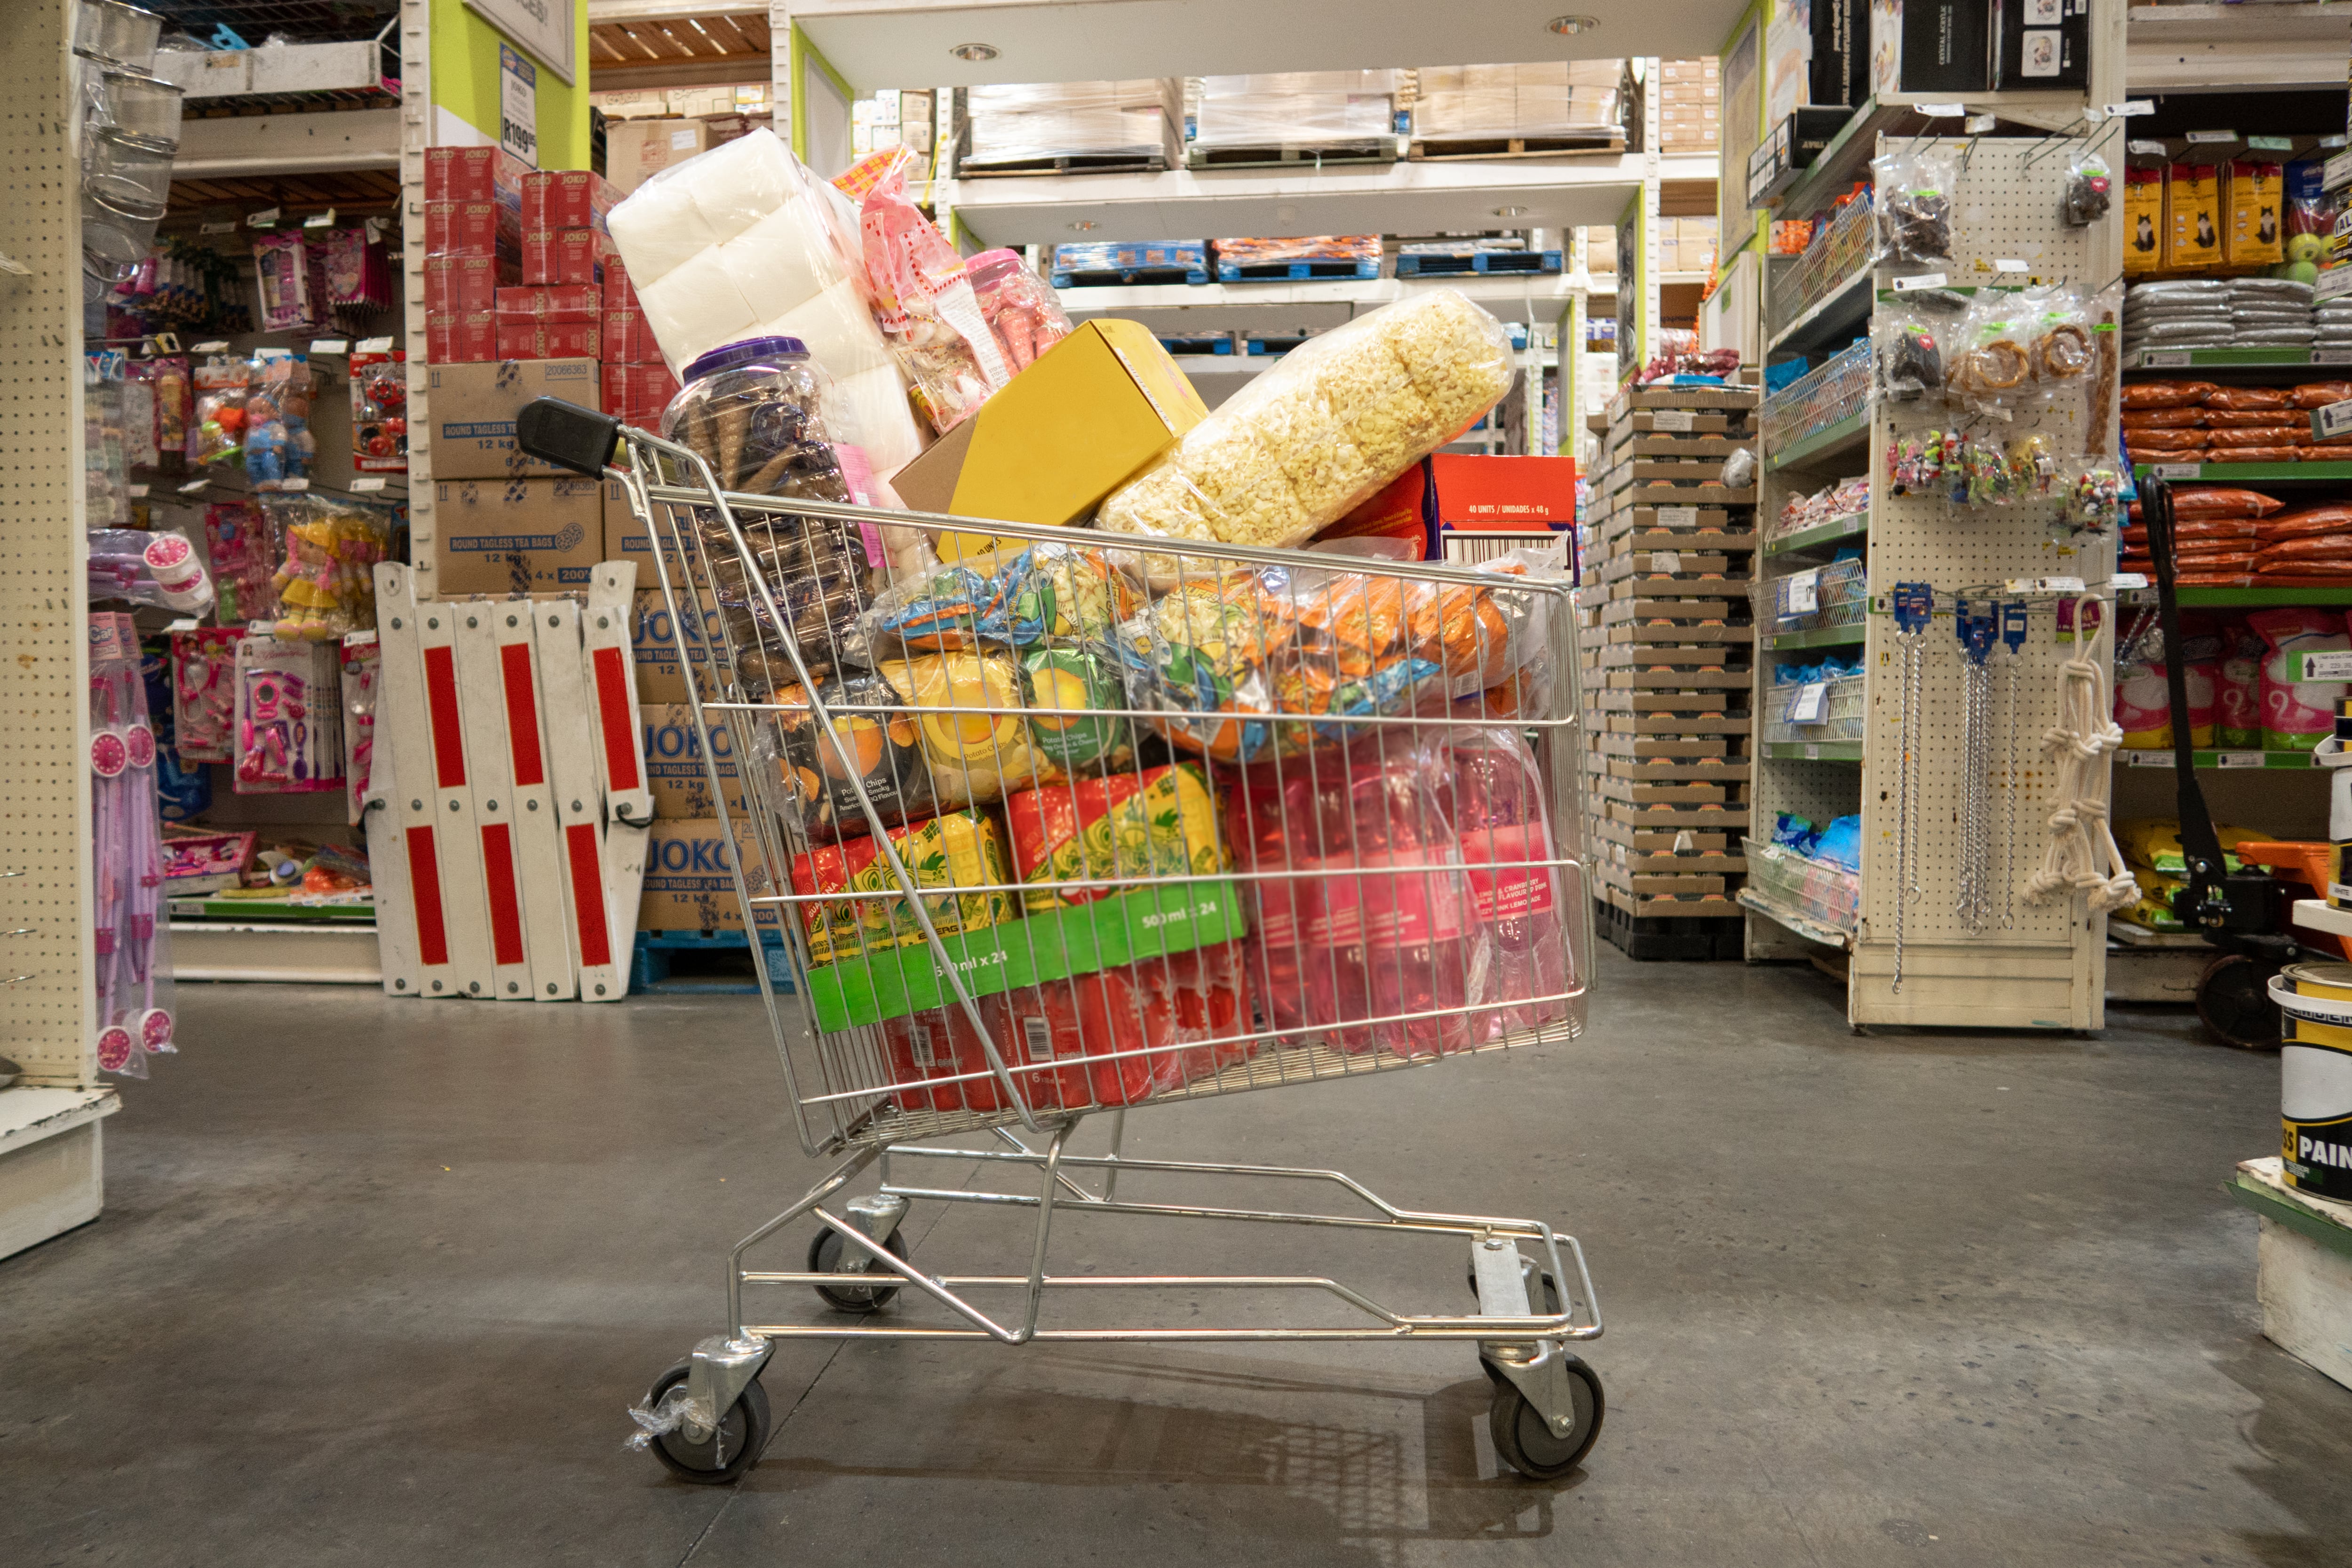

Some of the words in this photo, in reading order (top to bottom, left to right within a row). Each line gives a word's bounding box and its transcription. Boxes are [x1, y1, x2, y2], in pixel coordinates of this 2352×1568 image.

[464, 150, 490, 159] JOKO
[561, 175, 588, 185] JOKO
[465, 205, 492, 215] JOKO
[563, 232, 590, 243] JOKO
[463, 259, 490, 270] JOKO
[587, 289, 597, 318] JOKO
[536, 328, 546, 357] JOKO
[587, 327, 597, 356] JOKO
[445, 424, 471, 436] ROUND
[473, 423, 506, 435] TAGLESS
[477, 440, 493, 450] 12
[498, 439, 514, 450] kg
[1469, 504, 1477, 514] 40
[1478, 504, 1495, 514] UNITS
[1502, 505, 1530, 514] UNIDADES
[1536, 505, 1544, 513] 48
[1545, 507, 1549, 516] g
[452, 539, 478, 549] ROUND
[480, 539, 514, 549] TAGLESS
[515, 538, 530, 548] TEA
[531, 537, 553, 548] BAGS
[484, 554, 501, 563] 12
[535, 571, 544, 580] 4
[547, 572, 554, 580] x
[562, 570, 589, 580] 200'
[690, 650, 705, 660] TEA
[658, 665, 675, 675] 12
[1066, 732, 1088, 741] Chips
[663, 765, 696, 775] TAGLESS
[717, 765, 736, 775] BAGS
[667, 780, 683, 789] 12
[689, 780, 705, 791] kg
[866, 777, 887, 789] Chips
[868, 785, 890, 796] Smoky
[839, 802, 862, 812] America
[644, 838, 743, 874] JOKO
[668, 878, 701, 889] TAGLESS
[704, 878, 717, 888] TEA
[720, 878, 736, 888] BAG
[1498, 886, 1534, 901] FLAVOURD
[1534, 882, 1548, 891] DRINK
[673, 894, 688, 903] 12
[693, 894, 709, 903] kg
[1510, 895, 1542, 909] LEMOADE
[723, 911, 731, 920] 4
[1142, 913, 1167, 930] 500
[1168, 907, 1187, 923] ml
[1199, 901, 1217, 915] 24
[960, 957, 977, 971] ml
[979, 956, 989, 967] x
[991, 950, 1009, 964] 24
[1002, 1028, 1011, 1057] RECYCLE
[1032, 1072, 1041, 1083] 6
